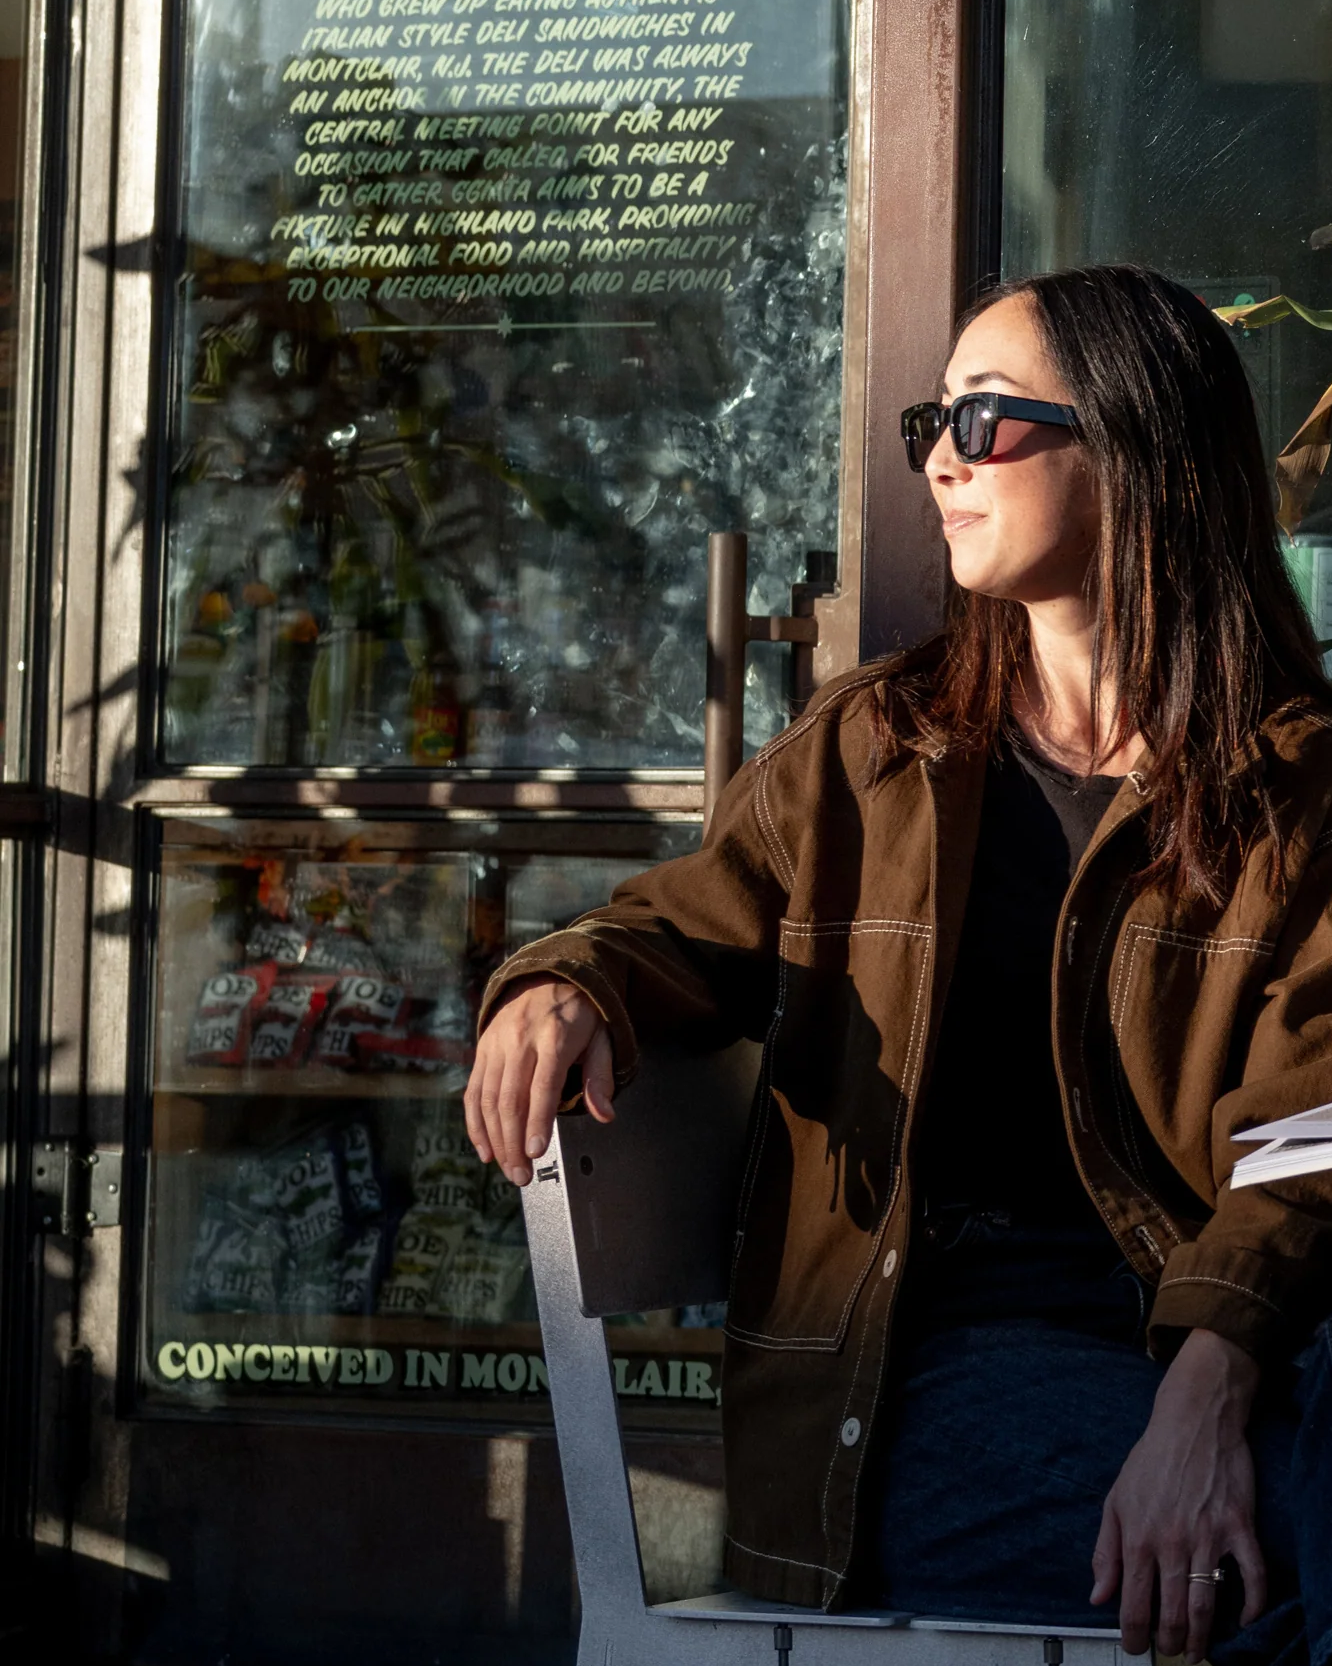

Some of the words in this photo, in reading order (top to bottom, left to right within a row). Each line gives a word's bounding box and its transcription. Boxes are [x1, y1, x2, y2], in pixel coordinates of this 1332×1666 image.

[302, 24, 388, 51] ITALIAN
[398, 21, 471, 48] STYLE
[476, 20, 528, 46] DELI
[534, 13, 693, 43] SANDWICHES
[702, 11, 734, 35] IN
[283, 55, 422, 85] MONTCLAIR,
[482, 50, 527, 75] THE
[534, 48, 587, 73] DELI
[593, 46, 645, 72] WAS
[653, 42, 752, 68] ALWAYS
[290, 89, 327, 114] AN
[332, 85, 427, 112] ANCHOR
[441, 85, 462, 108] IN
[475, 82, 521, 106] THE
[526, 76, 683, 106] COMMUNITY,
[694, 75, 743, 100] THE
[305, 118, 405, 146] CENTRAL
[414, 114, 524, 142] MEETING
[530, 111, 609, 136] POINT
[615, 111, 664, 134] FOR
[668, 107, 722, 132] ANY
[295, 150, 408, 176] OCCASION
[419, 147, 478, 172] THAT
[575, 143, 619, 167] FOR
[628, 140, 734, 166] FRIENDS
[319, 184, 347, 206] TO
[452, 178, 530, 203] GGIATA
[537, 176, 600, 200] AIMS
[611, 174, 643, 198] TO
[649, 173, 683, 197] BE
[688, 172, 709, 195] A
[271, 214, 370, 241] FIXTURE
[377, 212, 405, 237] IN
[415, 208, 536, 235] HIGHLAND
[542, 208, 610, 233] PARK,
[618, 203, 755, 230] PROVIDING
[286, 244, 440, 270] EXCEPTIONAL
[449, 242, 510, 267] FOOD
[517, 239, 571, 264] AND
[578, 236, 735, 262] HOSPITALITY
[288, 278, 316, 303] TO
[323, 276, 372, 301] OUR
[377, 271, 565, 299] NEIGHBORHOOD
[570, 269, 623, 295] AND
[632, 267, 735, 293] BEYOND.
[158, 1341, 394, 1386] CONCEIVED
[404, 1349, 450, 1387] IN
[461, 1351, 722, 1407] MONLAIR,
